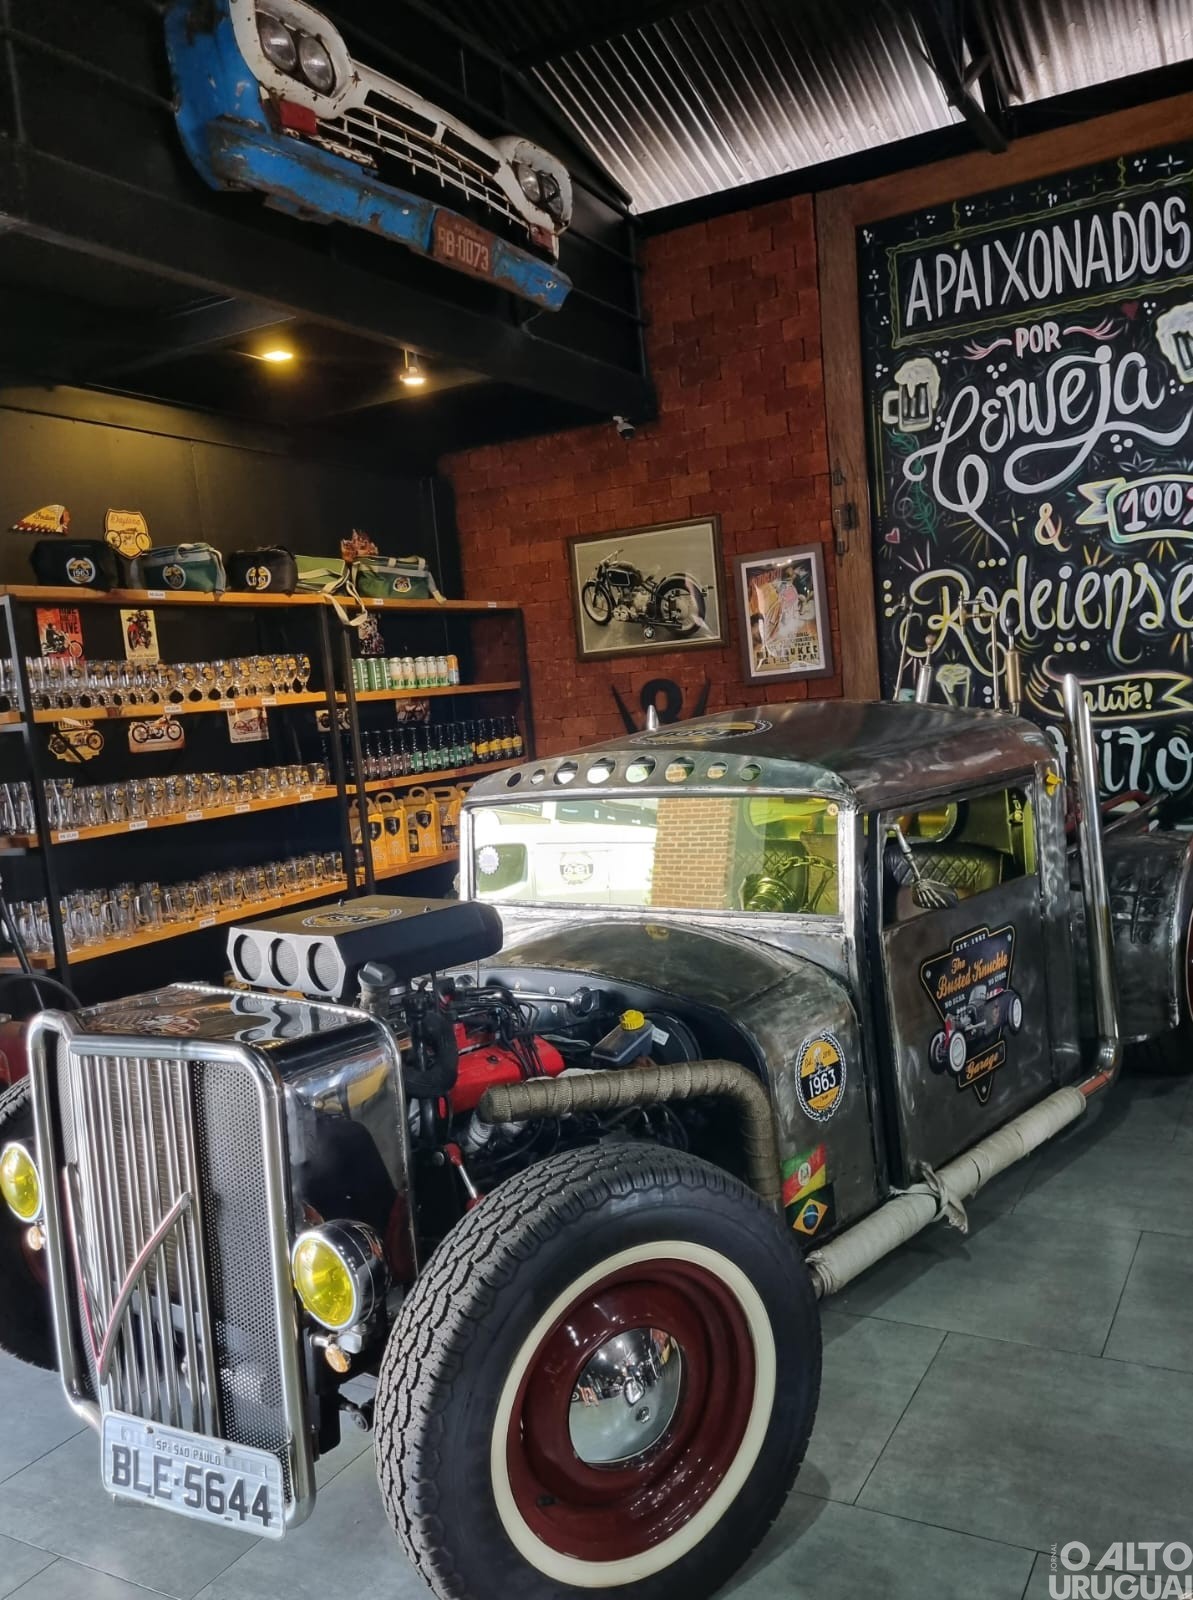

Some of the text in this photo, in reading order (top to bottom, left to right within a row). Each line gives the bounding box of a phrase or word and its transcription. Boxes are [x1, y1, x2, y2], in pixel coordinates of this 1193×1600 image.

[906, 196, 1191, 327] APAIXONADOS
[1015, 322, 1062, 359] POR
[903, 345, 1191, 510] Cerveja
[1035, 502, 1072, 552] &
[1053, 681, 1153, 712] alute!
[809, 1068, 836, 1098] 1963
[966, 1052, 999, 1081] Garage
[192, 1450, 221, 1466] PAULO
